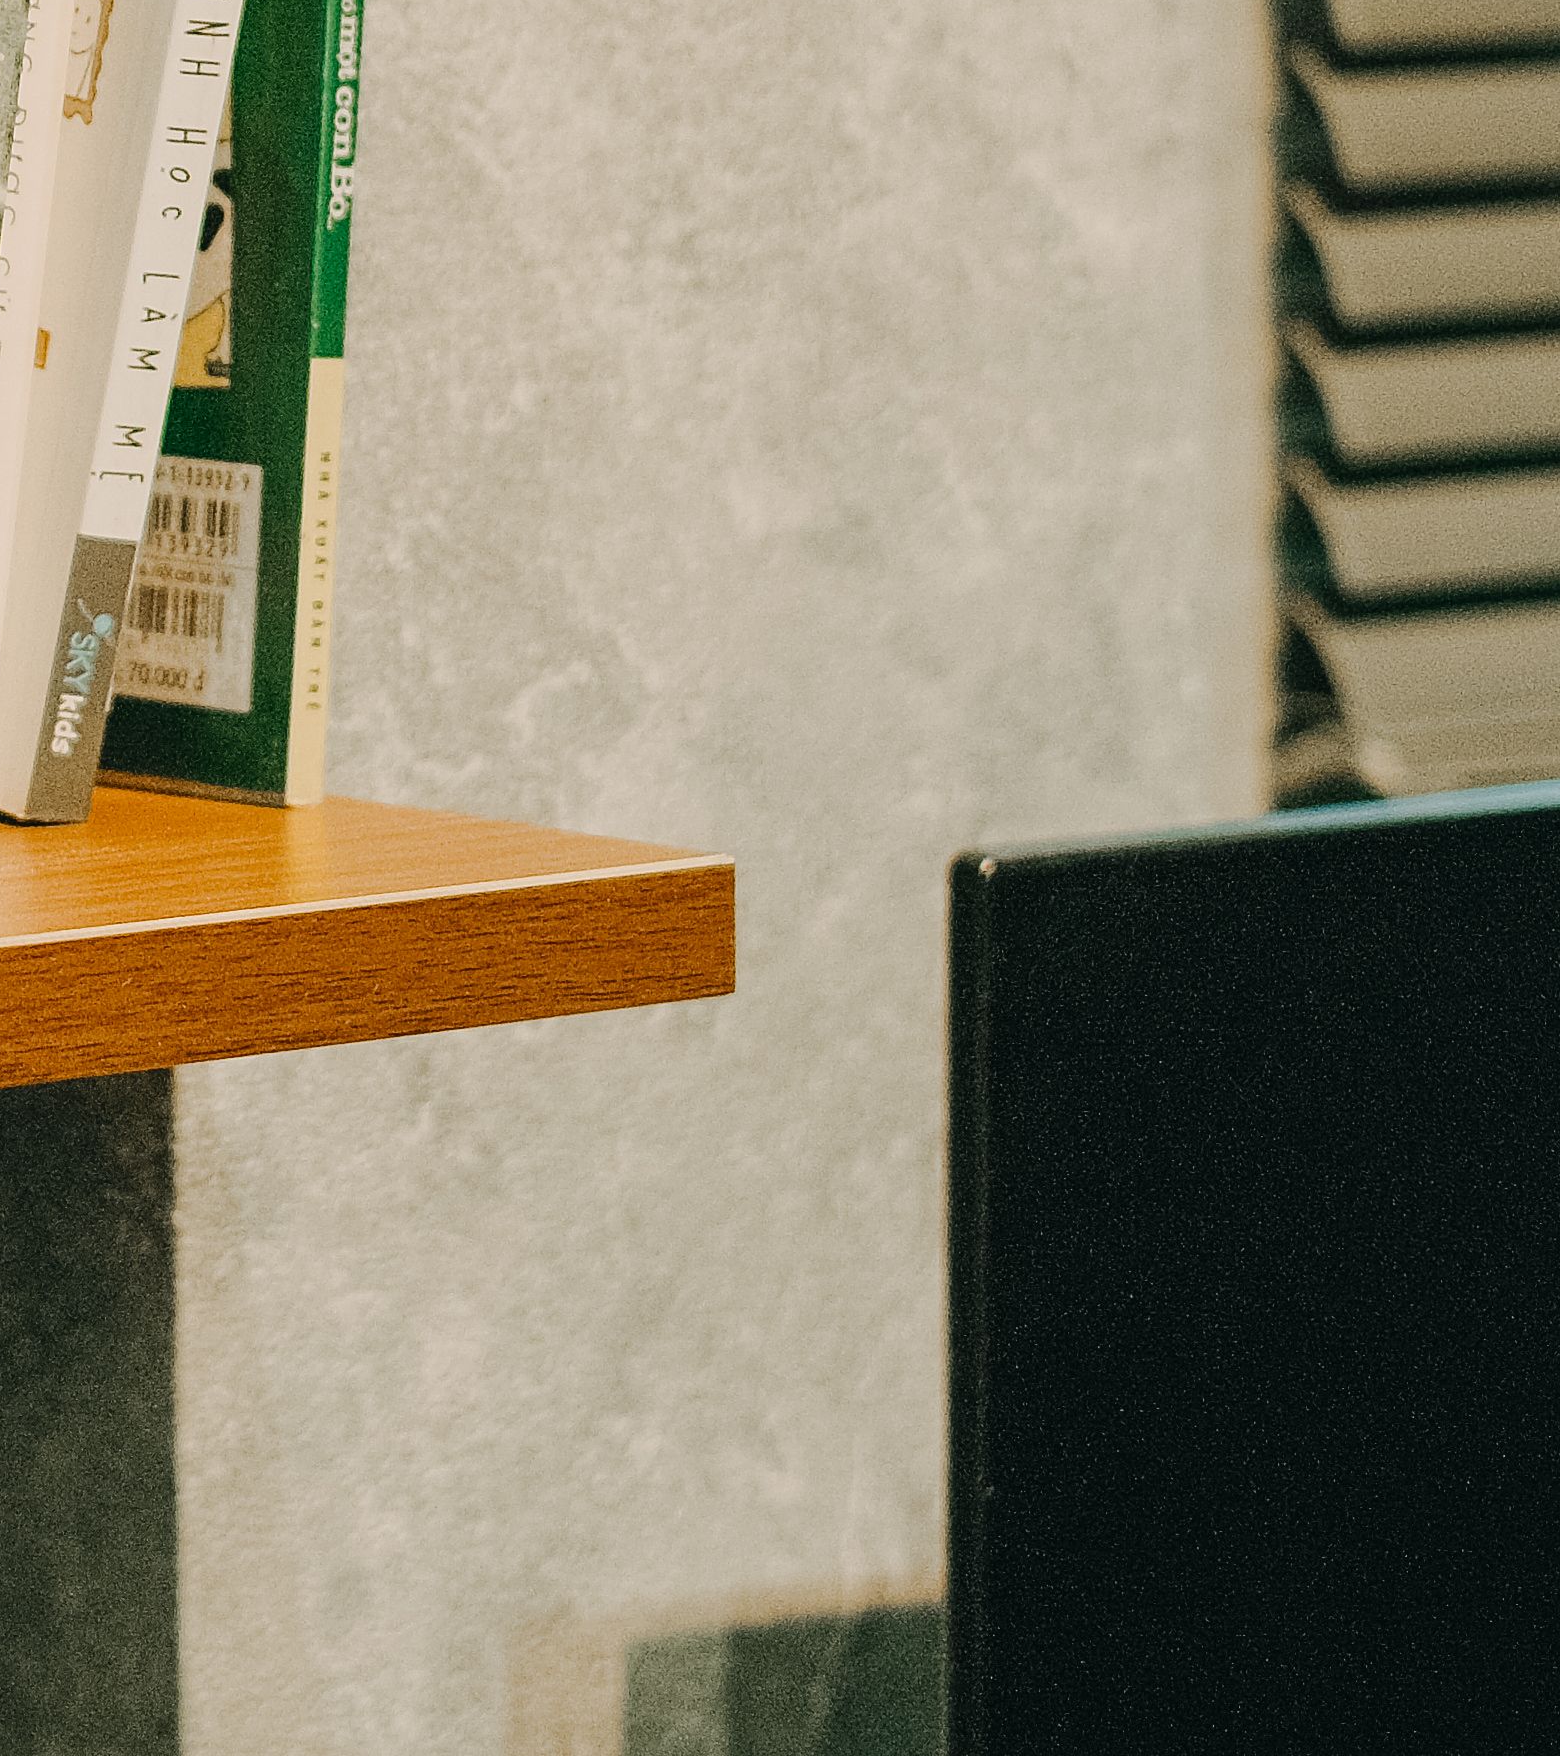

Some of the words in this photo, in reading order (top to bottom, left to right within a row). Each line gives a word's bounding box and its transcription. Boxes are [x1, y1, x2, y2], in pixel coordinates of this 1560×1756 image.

[161, 126, 207, 220] HỌC
[129, 272, 179, 372] LÀM
[88, 418, 153, 488] MẸ
